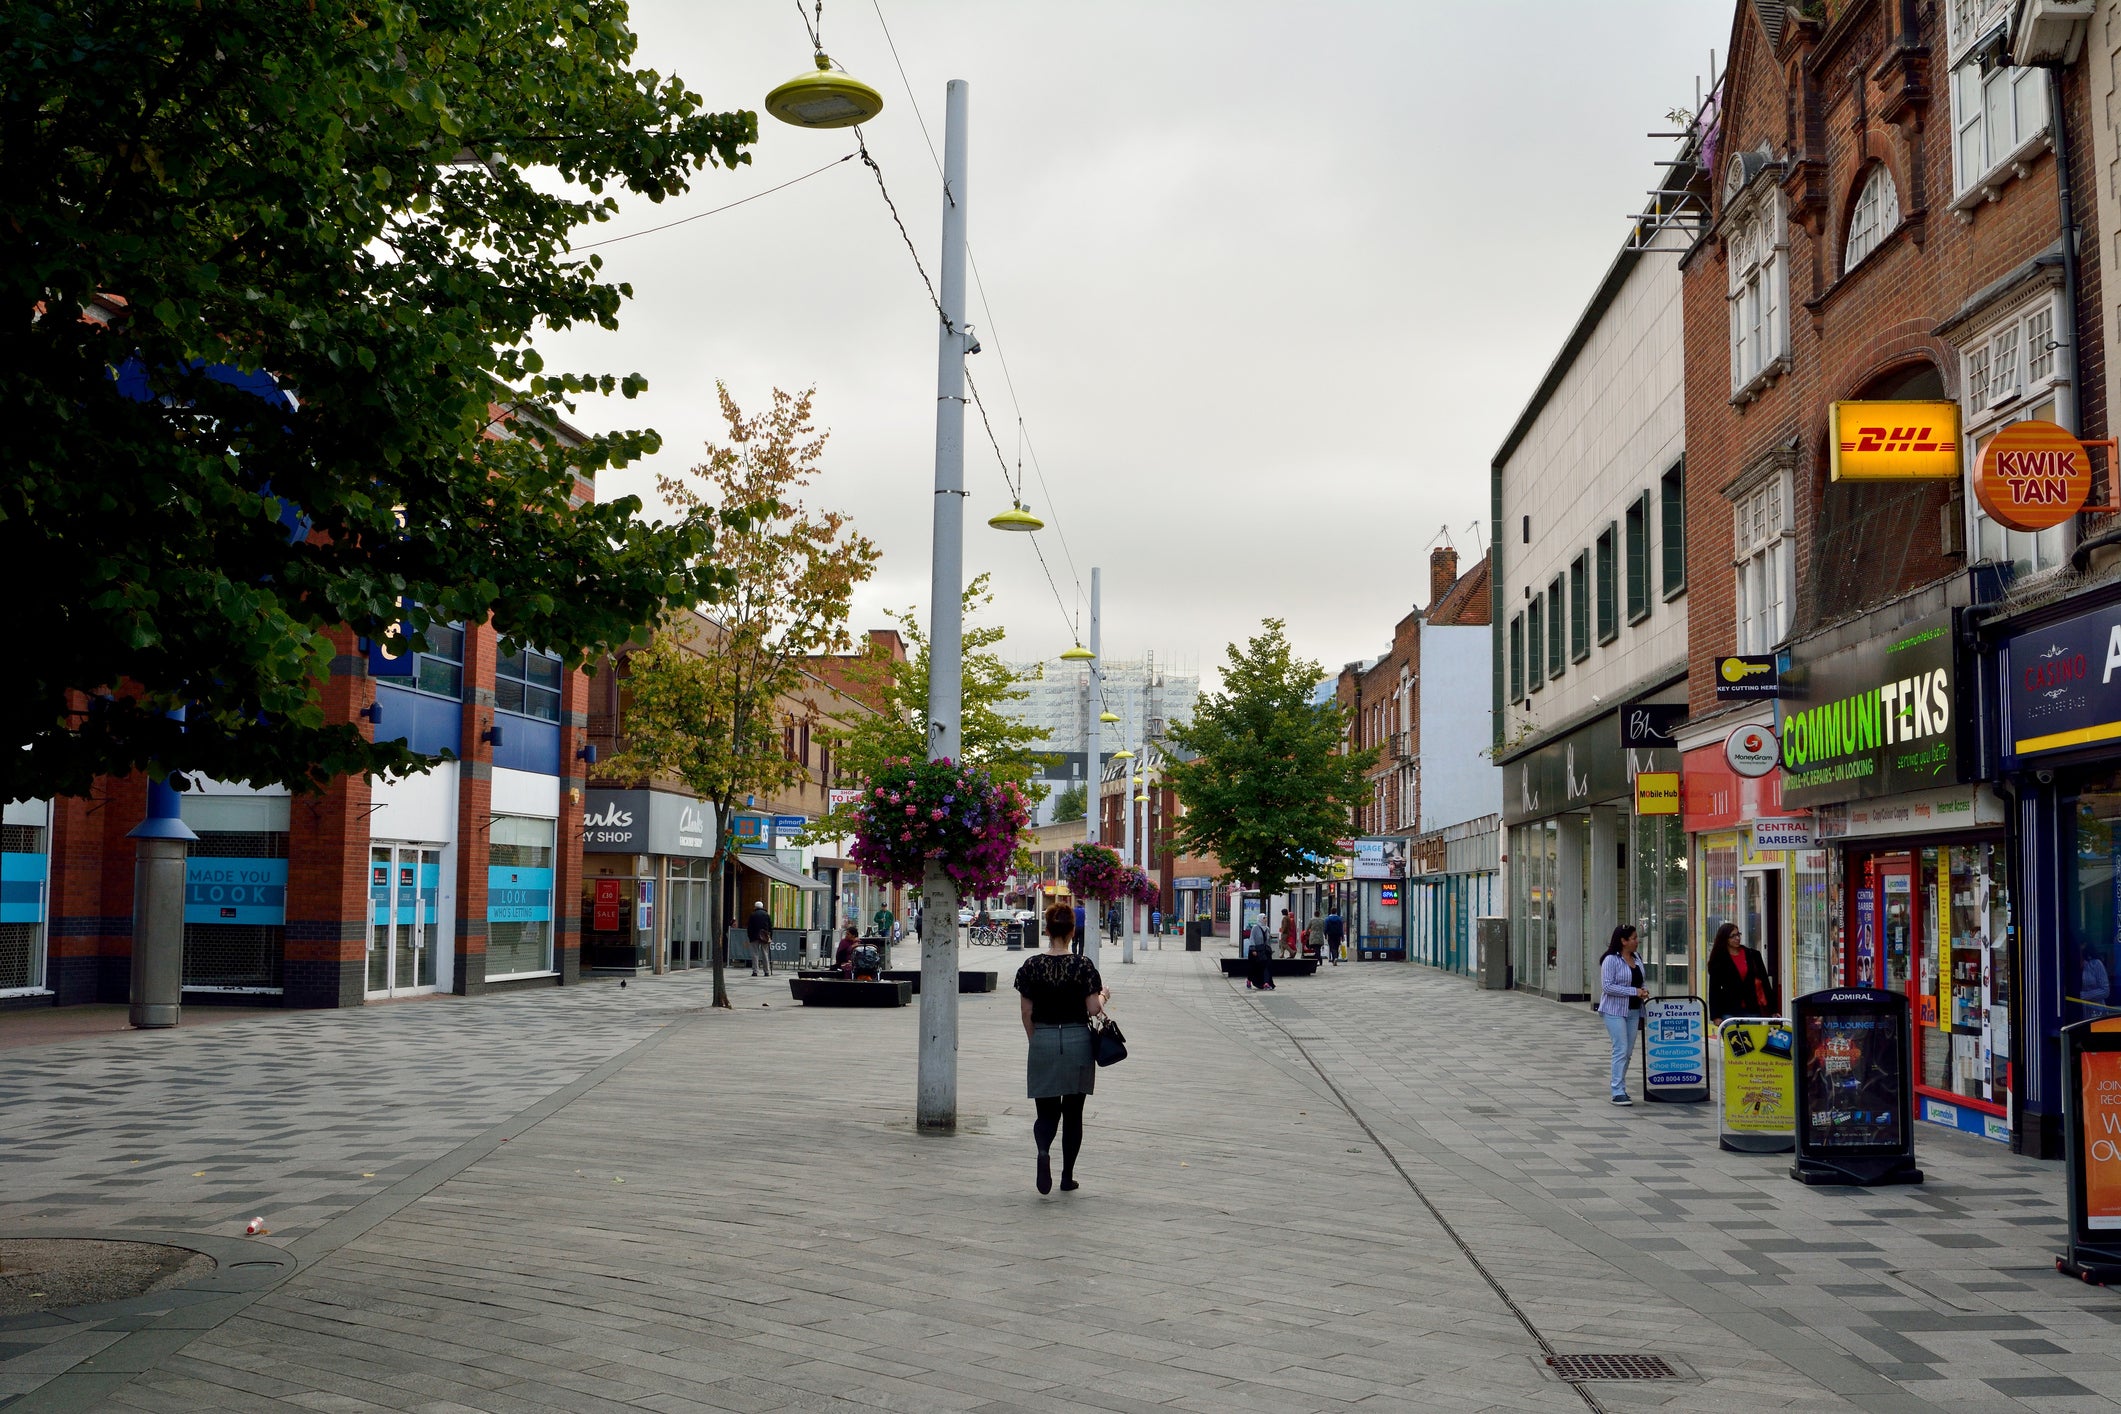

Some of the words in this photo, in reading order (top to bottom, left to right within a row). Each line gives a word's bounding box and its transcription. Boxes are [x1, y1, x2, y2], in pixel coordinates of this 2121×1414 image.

[1857, 428, 1938, 452] DHL
[1996, 451, 2078, 477] KWIK
[2006, 478, 2068, 504] TAN
[2024, 654, 2086, 692] CASINO
[1783, 668, 1948, 768] COMMUNITEKS
[1920, 752, 1930, 771] you
[1931, 743, 1949, 762] better
[1845, 758, 1873, 780] LOCKING
[1664, 790, 1677, 798] Hub
[1915, 803, 1930, 818] Printing
[1937, 802, 1953, 814] Internet
[1955, 800, 1970, 812] Access
[1756, 823, 1808, 831] CENTRAL
[597, 832, 632, 842] SHOP
[1759, 836, 1808, 844] BARBERS
[1762, 850, 1779, 862] WAIT
[190, 870, 234, 882] MADE
[240, 870, 271, 882] YOU
[1888, 878, 1908, 888] Lycamobile
[194, 886, 266, 903] LOOK
[502, 889, 526, 903] LOOK
[493, 908, 510, 918] WHO'S
[1921, 1000, 1935, 1023] Ria
[1931, 1106, 1953, 1120] Lycamobile
